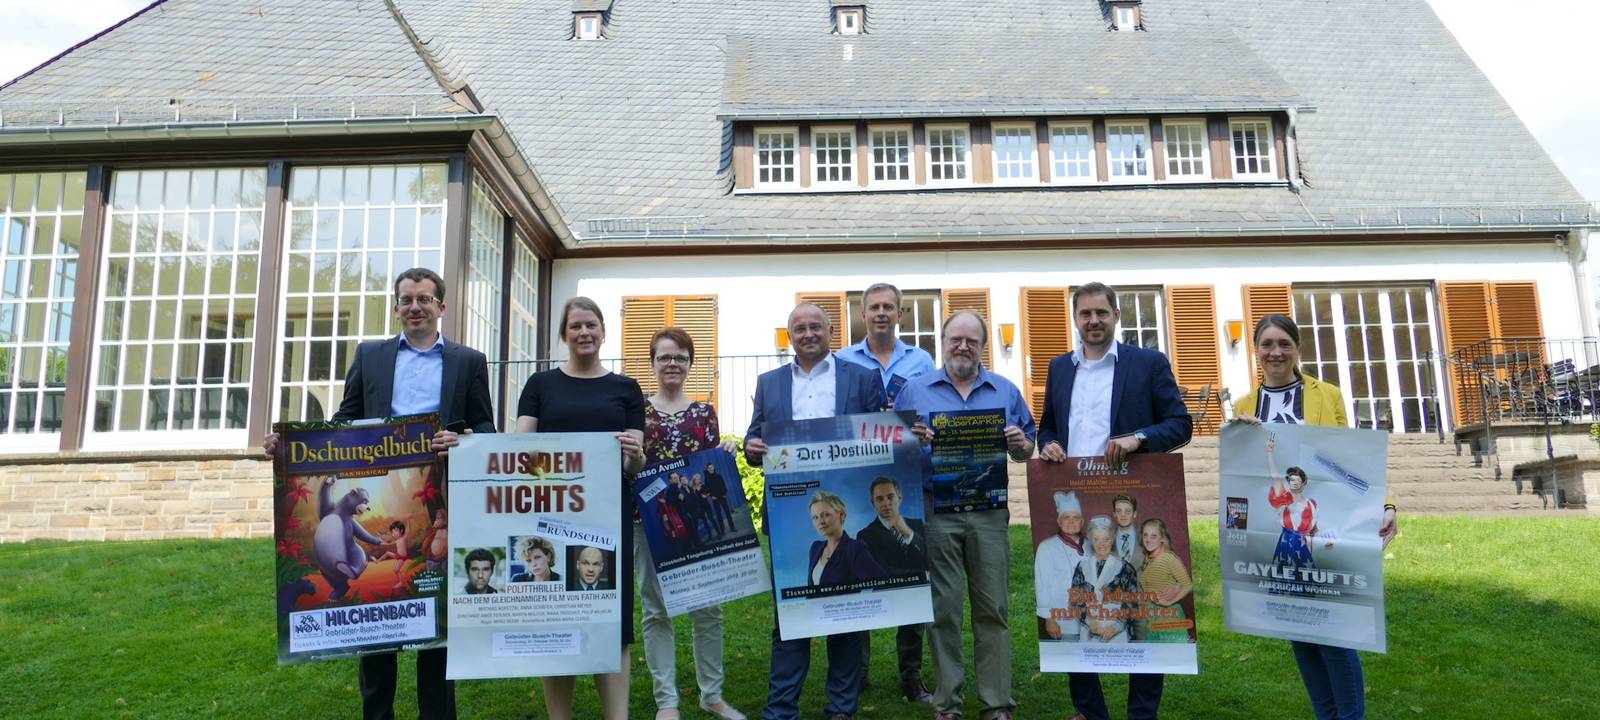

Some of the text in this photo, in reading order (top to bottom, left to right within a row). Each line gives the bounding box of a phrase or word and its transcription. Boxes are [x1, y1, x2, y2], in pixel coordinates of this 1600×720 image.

[860, 422, 904, 444] LIVE
[290, 432, 432, 464] Dschungelbuch
[796, 448, 823, 461] Der
[828, 442, 889, 462] Postillon
[487, 452, 584, 475] AUS DEM
[634, 458, 686, 480] asso Avanti
[485, 484, 586, 514] NICHTS
[547, 526, 614, 546] RUNDSCHAU
[1234, 561, 1368, 588] GAYLE TUFTS
[506, 584, 564, 594] POLITTHRILLER
[786, 575, 920, 598] Tickets: www.der-postillon-live.com
[1103, 587, 1160, 604] Mann
[1258, 580, 1341, 596] AMERICAN WOMAN
[474, 596, 490, 604] DEM
[492, 594, 548, 604] GLEICHNAMIGEN
[549, 594, 565, 602] FILM
[601, 592, 617, 600] AKIN
[325, 601, 427, 627] HILCHENBACH
[1050, 604, 1181, 620] mit Charakter
